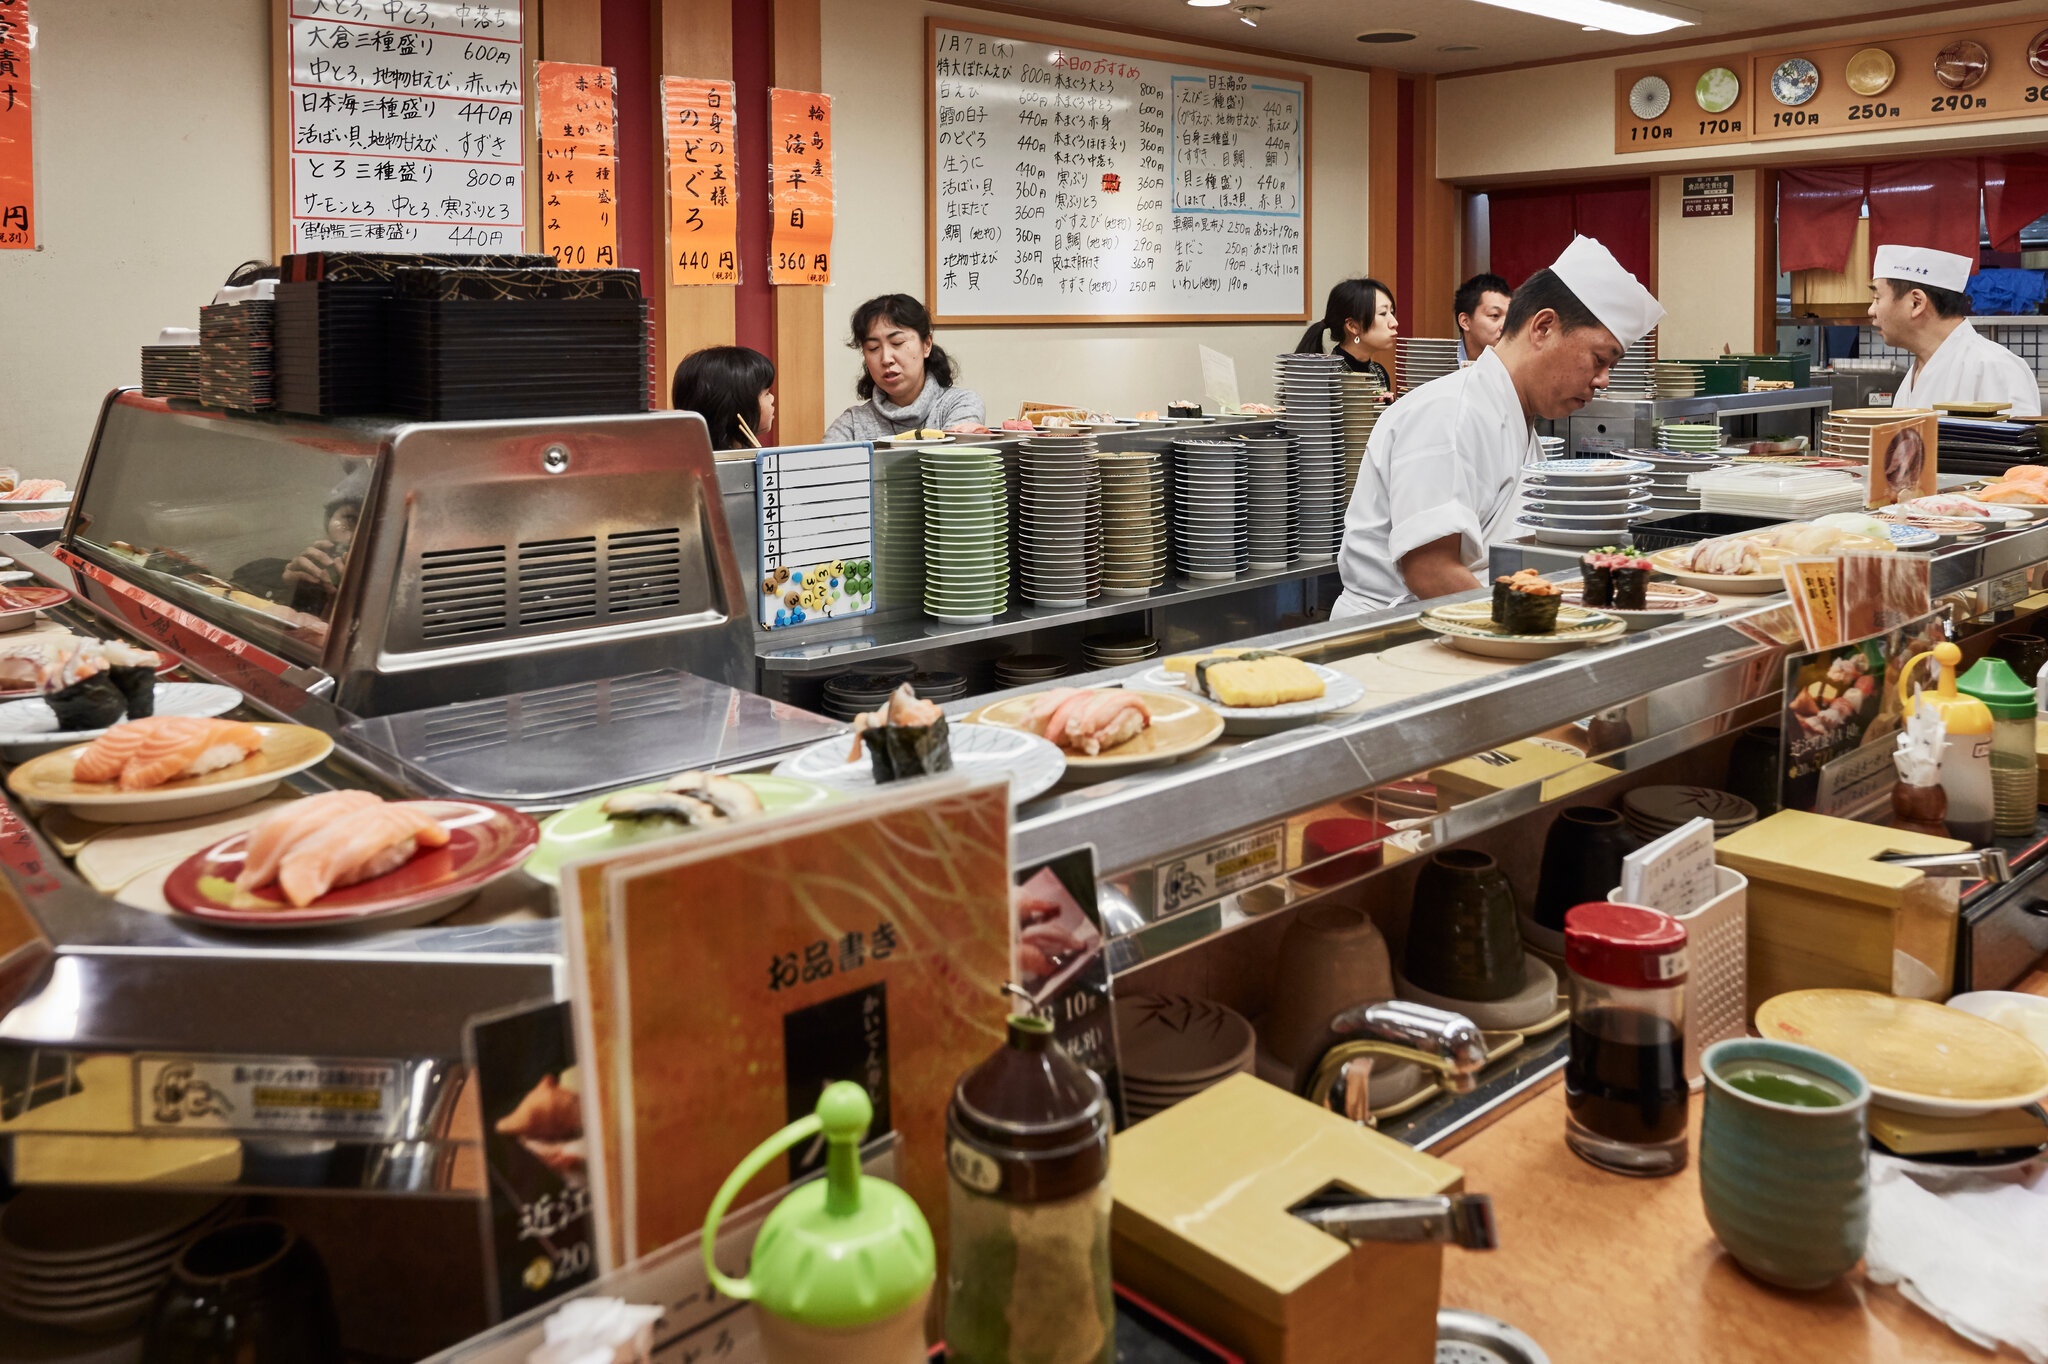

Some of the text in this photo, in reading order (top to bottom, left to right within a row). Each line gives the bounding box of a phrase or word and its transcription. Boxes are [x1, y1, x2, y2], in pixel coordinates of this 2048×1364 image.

[308, 25, 433, 56] 大倉三種盛り
[937, 58, 1051, 84] 特大ぼたんえび 800円
[1052, 50, 1140, 80] 本日のおすすめ
[1055, 74, 1164, 100] 本まぐろ大とろ 800円
[302, 92, 512, 125] 日本海三種盛り 440円
[1139, 103, 1164, 118] 600円
[1263, 102, 1292, 117] 440円
[1931, 94, 1987, 112] 290円
[1019, 110, 1047, 127] 440円
[1774, 111, 1819, 127] 190円
[1848, 103, 1900, 120] 250円
[1140, 121, 1164, 137] 360円
[1631, 125, 1672, 140] 110円
[1700, 119, 1741, 135] 170円
[459, 131, 506, 158] すずき
[707, 88, 729, 207] 白身の王様
[808, 104, 826, 177] 輪島産
[940, 131, 1046, 152] のどぐろ 440円
[1140, 139, 1164, 154] 360円
[1265, 136, 1290, 150] 440円
[563, 123, 577, 184] 生げそ
[679, 108, 705, 232] のどぐろ
[944, 154, 1045, 179] 生うに 440円
[1140, 156, 1164, 172] 290円
[466, 169, 515, 187] 800円
[785, 133, 807, 229] 活平目
[1137, 176, 1164, 191] 360円
[1257, 174, 1285, 190] 440円
[547, 148, 561, 230] いかみみ
[943, 178, 1047, 199] 活ばい貝 360円
[1137, 196, 1162, 211] 600円
[1015, 205, 1045, 220] 360円
[1137, 218, 1163, 234] 360円
[1227, 222, 1250, 235] 250円
[448, 226, 503, 246] 440円
[1016, 228, 1041, 244] 360円
[1133, 237, 1161, 253] 290円
[1225, 242, 1248, 256] 250円
[944, 250, 1042, 267] 地物甘えび 360円
[1131, 257, 1154, 270] 360円
[1224, 258, 1246, 271] 190円
[1013, 269, 1043, 287] 360円
[1130, 281, 1156, 292] 250円
[767, 457, 772, 469] 1
[766, 476, 775, 487] 2
[767, 493, 775, 506] 3
[766, 508, 776, 521] 4
[767, 525, 775, 537] 5
[768, 542, 775, 553] 6
[768, 557, 776, 569] 7
[767, 921, 900, 994] お品書き
